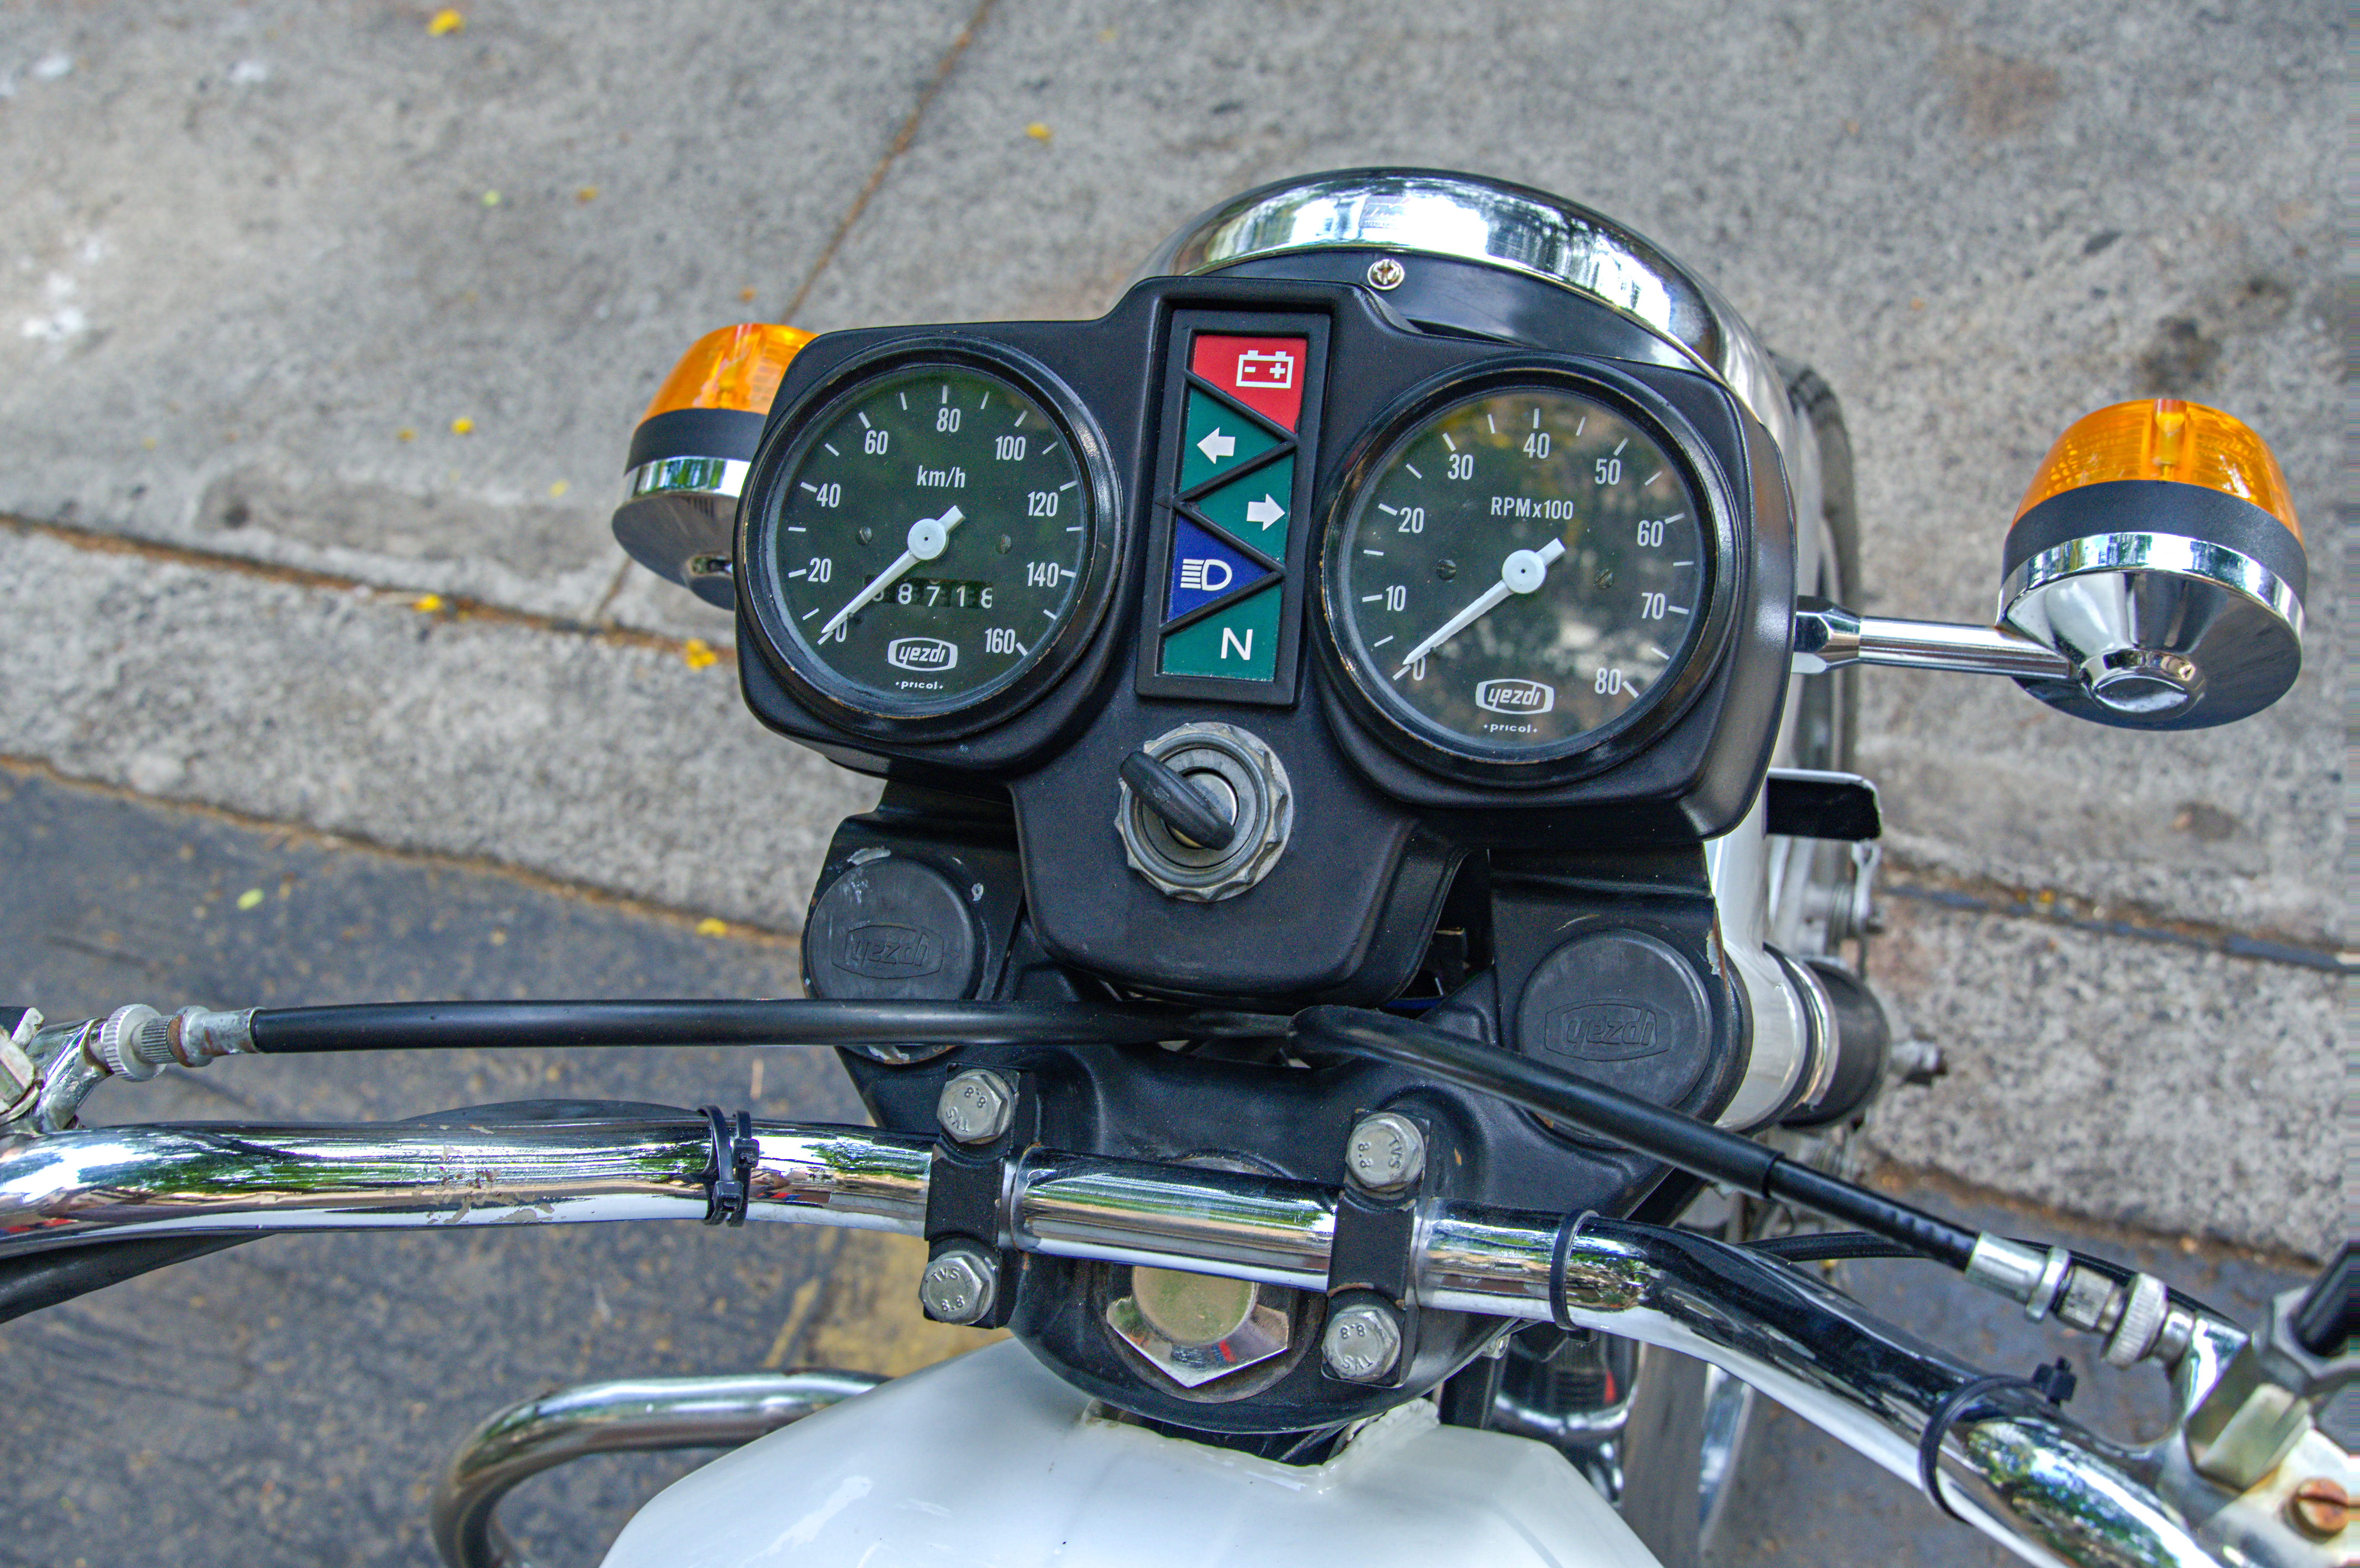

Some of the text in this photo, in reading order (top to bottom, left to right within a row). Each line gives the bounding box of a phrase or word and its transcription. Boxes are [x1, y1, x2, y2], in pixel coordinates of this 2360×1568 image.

[936, 407, 961, 433] 80
[865, 430, 888, 455] 60
[995, 436, 1026, 461] 100
[1523, 433, 1550, 459] 40
[917, 465, 966, 488] km/h
[1448, 454, 1473, 480] 30
[1595, 458, 1621, 485] 50
[817, 483, 841, 508] 40
[1028, 491, 1058, 517] 120
[1398, 507, 1424, 533] 20
[1637, 520, 1664, 547] 60
[808, 558, 832, 583] 20
[1027, 562, 1059, 588] 140
[1386, 585, 1406, 611] 10
[1641, 592, 1665, 620] 70
[835, 620, 847, 643] 0
[985, 628, 1016, 654] 160
[1221, 628, 1253, 660] N
[899, 644, 946, 664] yezdi
[1413, 656, 1426, 681] 0
[1595, 667, 1621, 695] 80
[901, 681, 938, 690] pricol
[1488, 685, 1541, 708] yezdi
[1490, 724, 1531, 733] pricol
[849, 930, 928, 969] yezdi
[1566, 1009, 1655, 1051] yezdi
